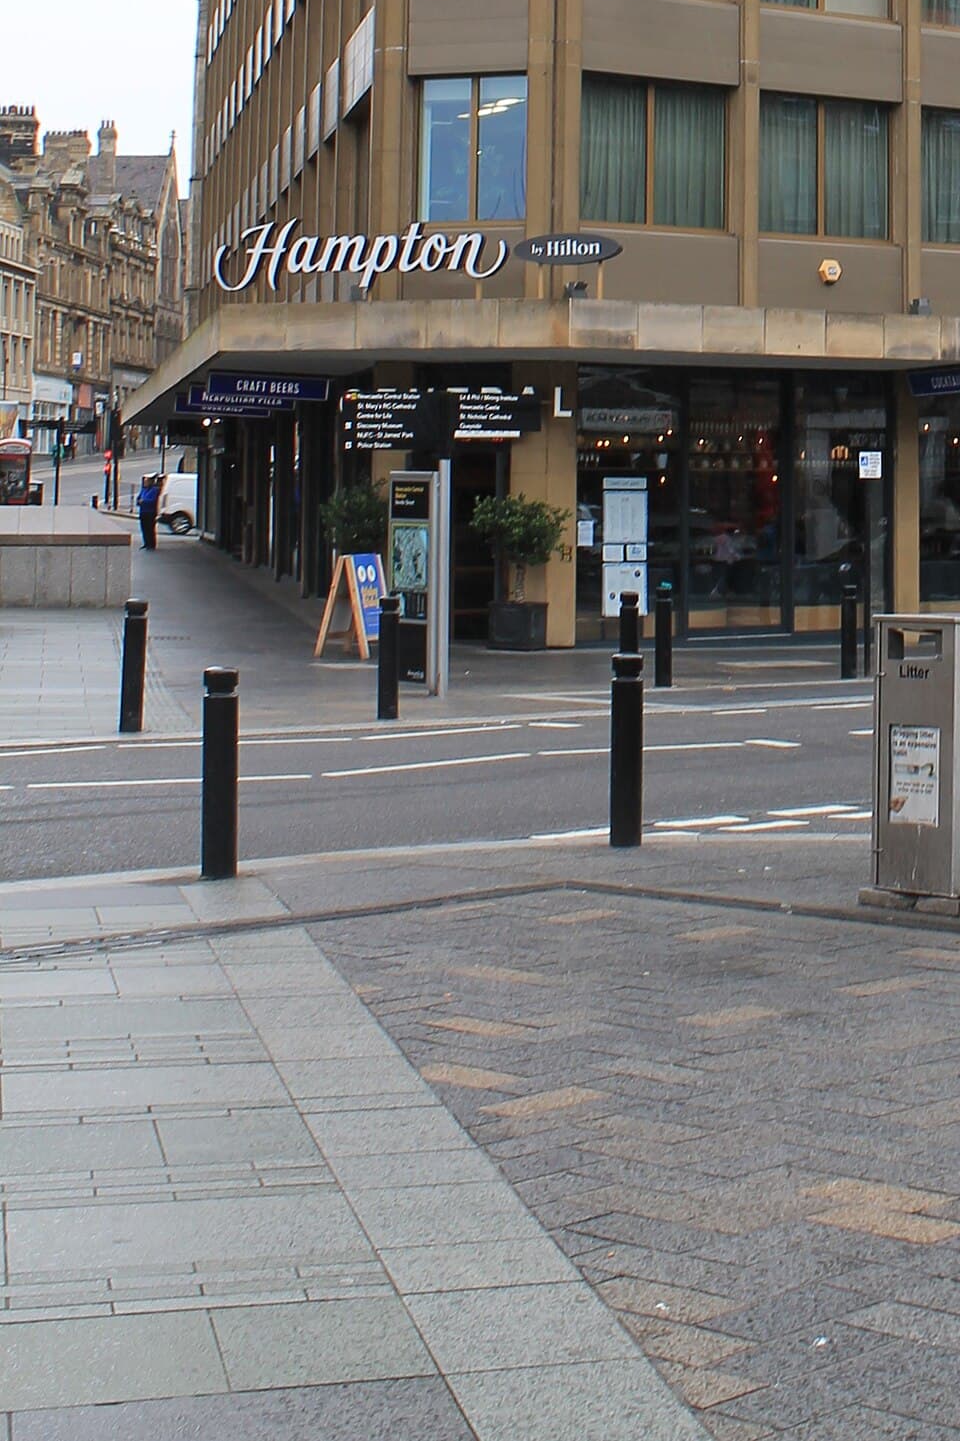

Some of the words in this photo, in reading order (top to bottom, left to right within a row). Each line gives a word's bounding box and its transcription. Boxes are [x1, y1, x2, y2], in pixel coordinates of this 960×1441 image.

[213, 217, 507, 292] Hampton
[531, 244, 544, 257] by
[546, 239, 602, 257] Hilton
[236, 379, 267, 392] CRAFT
[270, 381, 300, 394] BEERS
[900, 665, 930, 680] Litter
